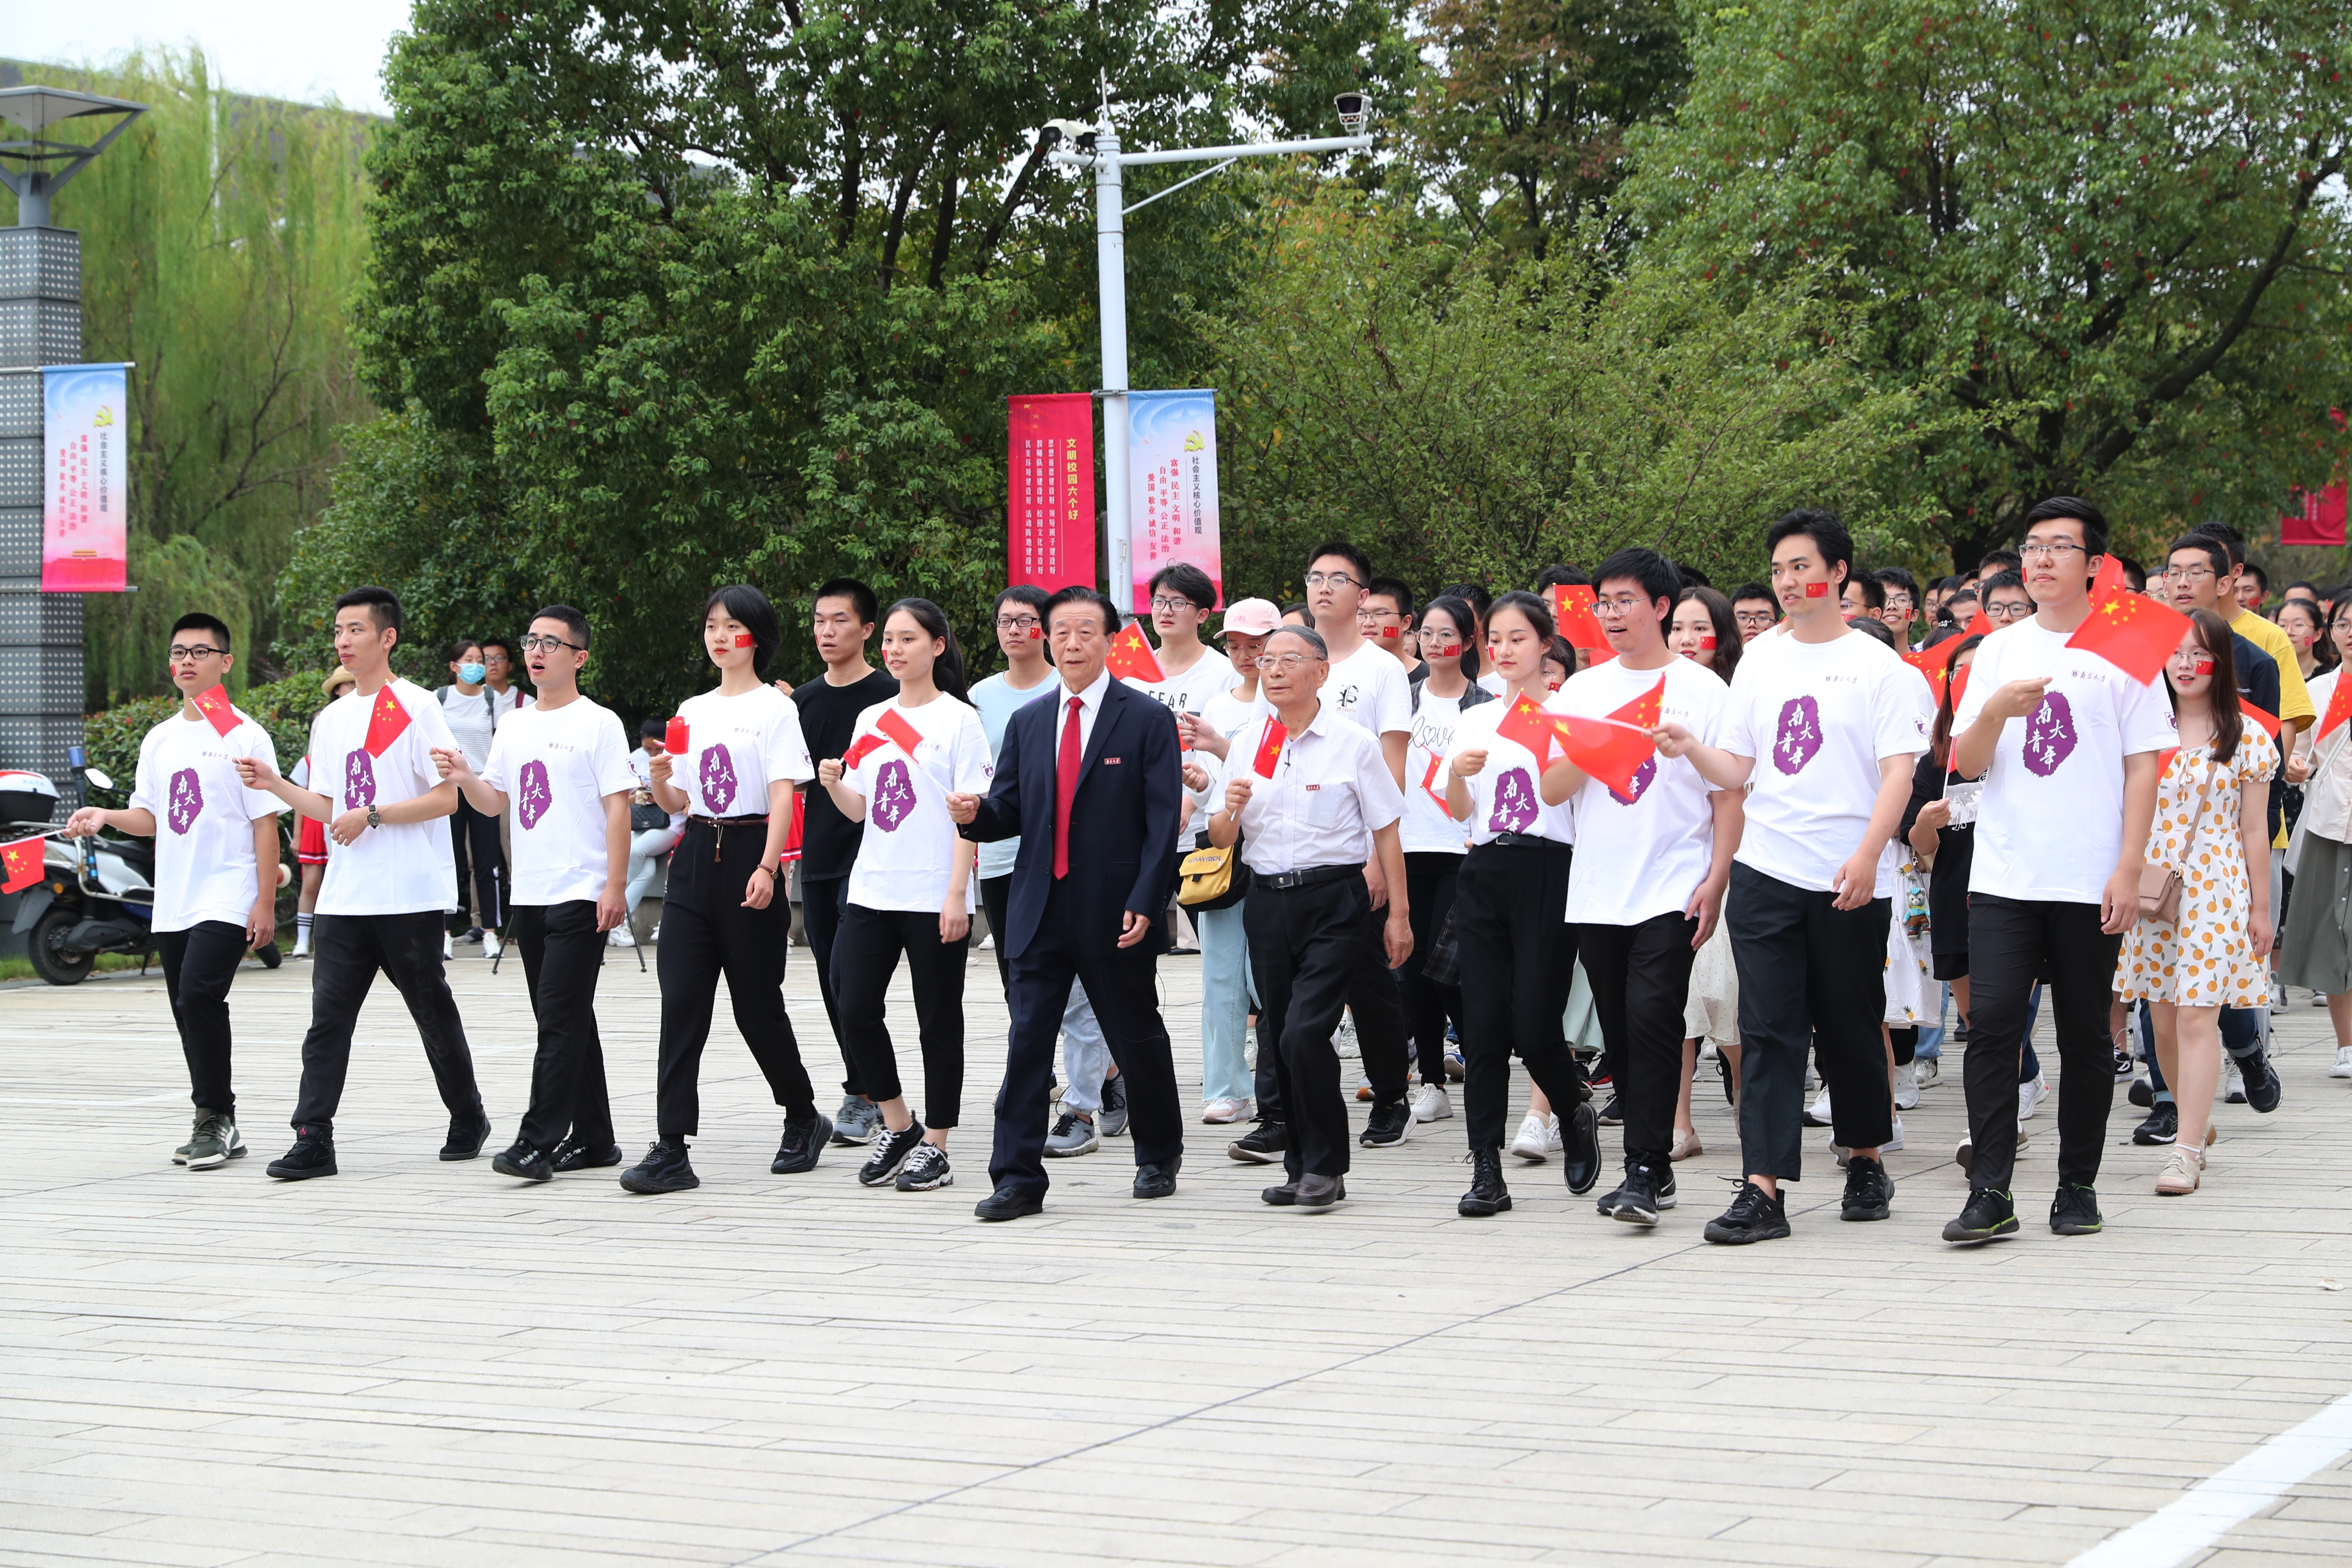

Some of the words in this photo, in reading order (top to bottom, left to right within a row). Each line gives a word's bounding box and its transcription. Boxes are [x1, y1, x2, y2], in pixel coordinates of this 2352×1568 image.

[80, 458, 88, 476] 民主
[1160, 466, 1167, 484] 自由
[1170, 459, 1179, 476] 富强
[1066, 438, 1078, 520] 文明校园六个好
[1148, 474, 1155, 491] 爱国
[69, 488, 77, 507] 公正
[80, 481, 88, 499] 文明
[1160, 489, 1168, 506] 平等
[1171, 481, 1179, 500] 民主
[1192, 456, 1202, 535] 社会主义核心价值观
[1148, 496, 1156, 514] 敬业
[1172, 505, 1180, 523] 文明
[1148, 519, 1156, 537] 诚信
[1160, 511, 1169, 530] 公正
[1161, 535, 1169, 553] 法治
[1173, 527, 1181, 545] 和谐
